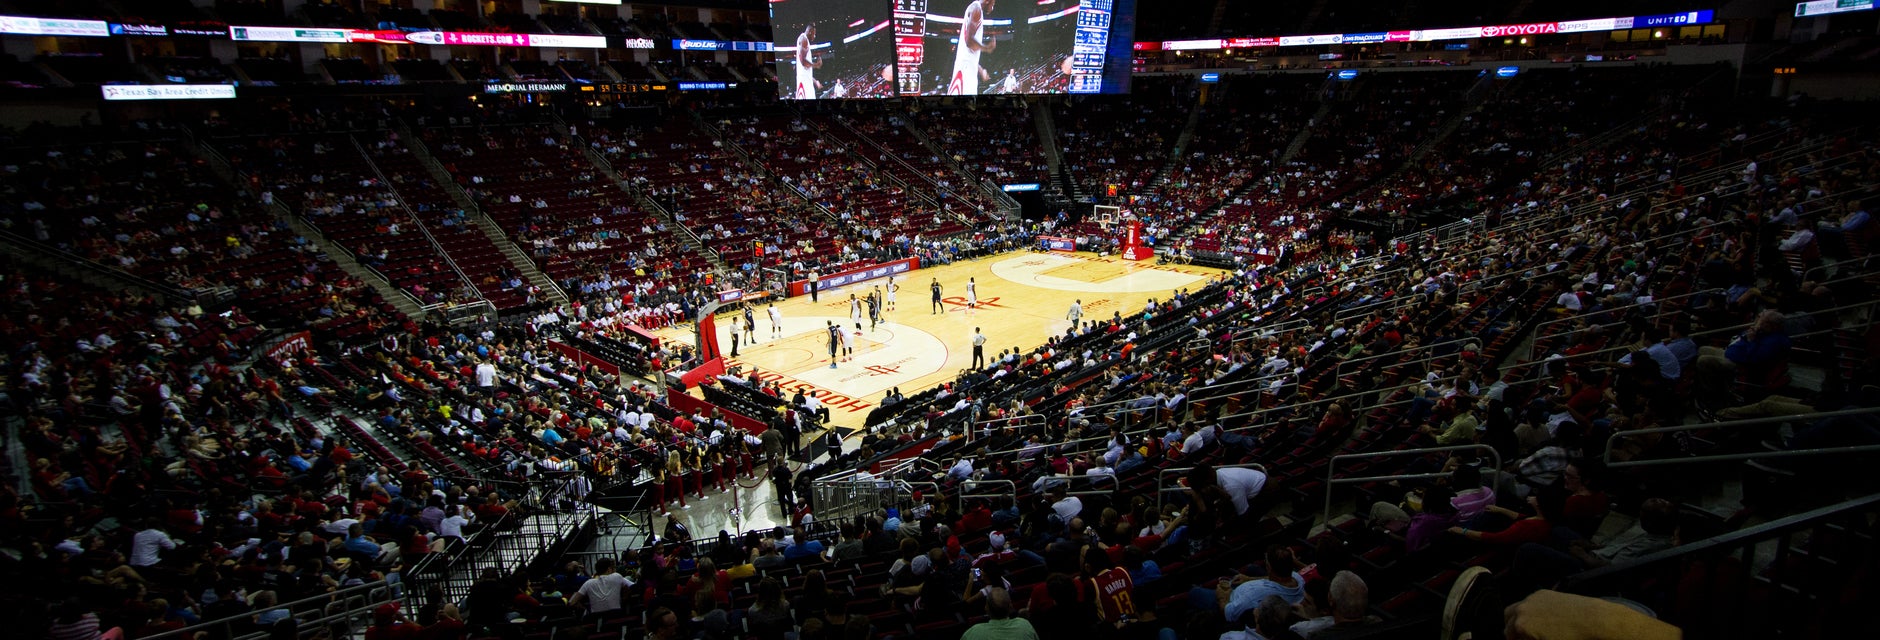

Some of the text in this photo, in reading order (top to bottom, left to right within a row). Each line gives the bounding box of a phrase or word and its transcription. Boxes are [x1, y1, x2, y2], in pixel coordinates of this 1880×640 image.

[1648, 15, 1687, 25] UNITED
[1501, 23, 1556, 36] TOYOTA
[1567, 22, 1589, 30] PPS
[461, 34, 514, 45] ROCKETS.COM
[120, 87, 145, 96] Texas
[147, 87, 162, 97] Bay
[165, 87, 183, 96] Area
[184, 86, 209, 96] Credit
[487, 83, 567, 92] MEMORIAL HERMANN
[1104, 578, 1127, 594] HARDEN
[1111, 590, 1135, 614] 13
